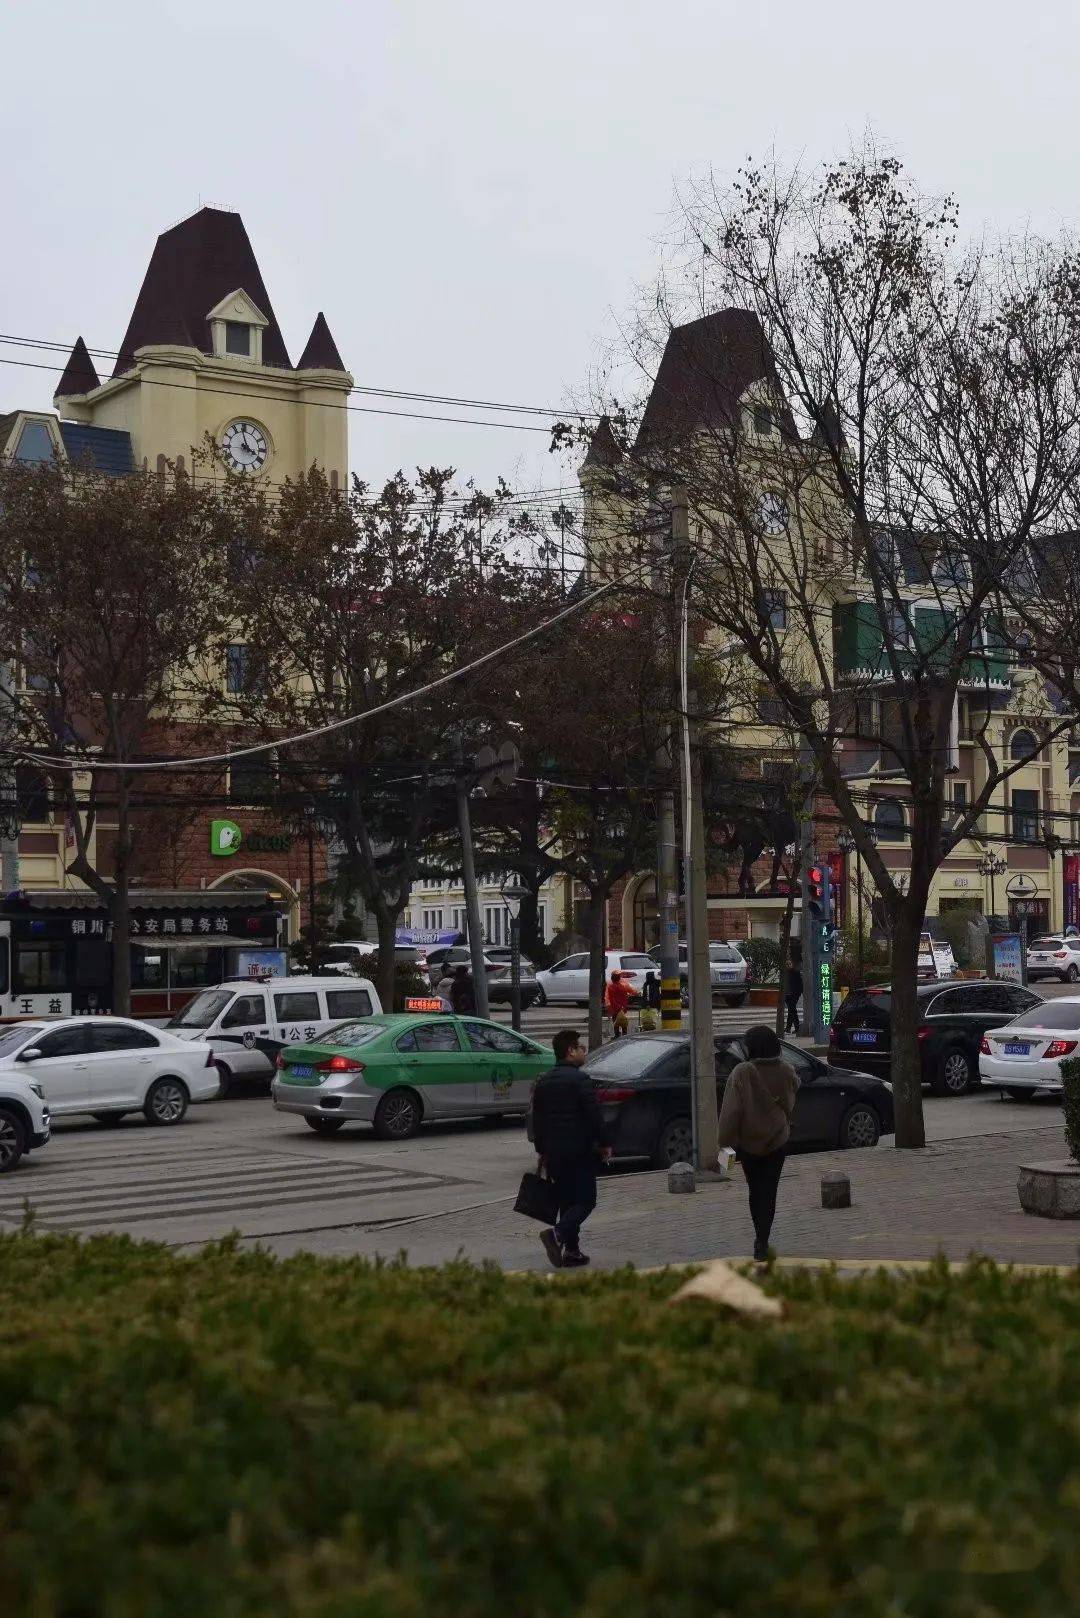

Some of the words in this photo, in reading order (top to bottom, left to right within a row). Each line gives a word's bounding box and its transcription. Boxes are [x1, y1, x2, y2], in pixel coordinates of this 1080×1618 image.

[820, 963, 831, 1026] 绿灯请通行
[19, 998, 62, 1014] 王益
[289, 1026, 316, 1040] 公安
